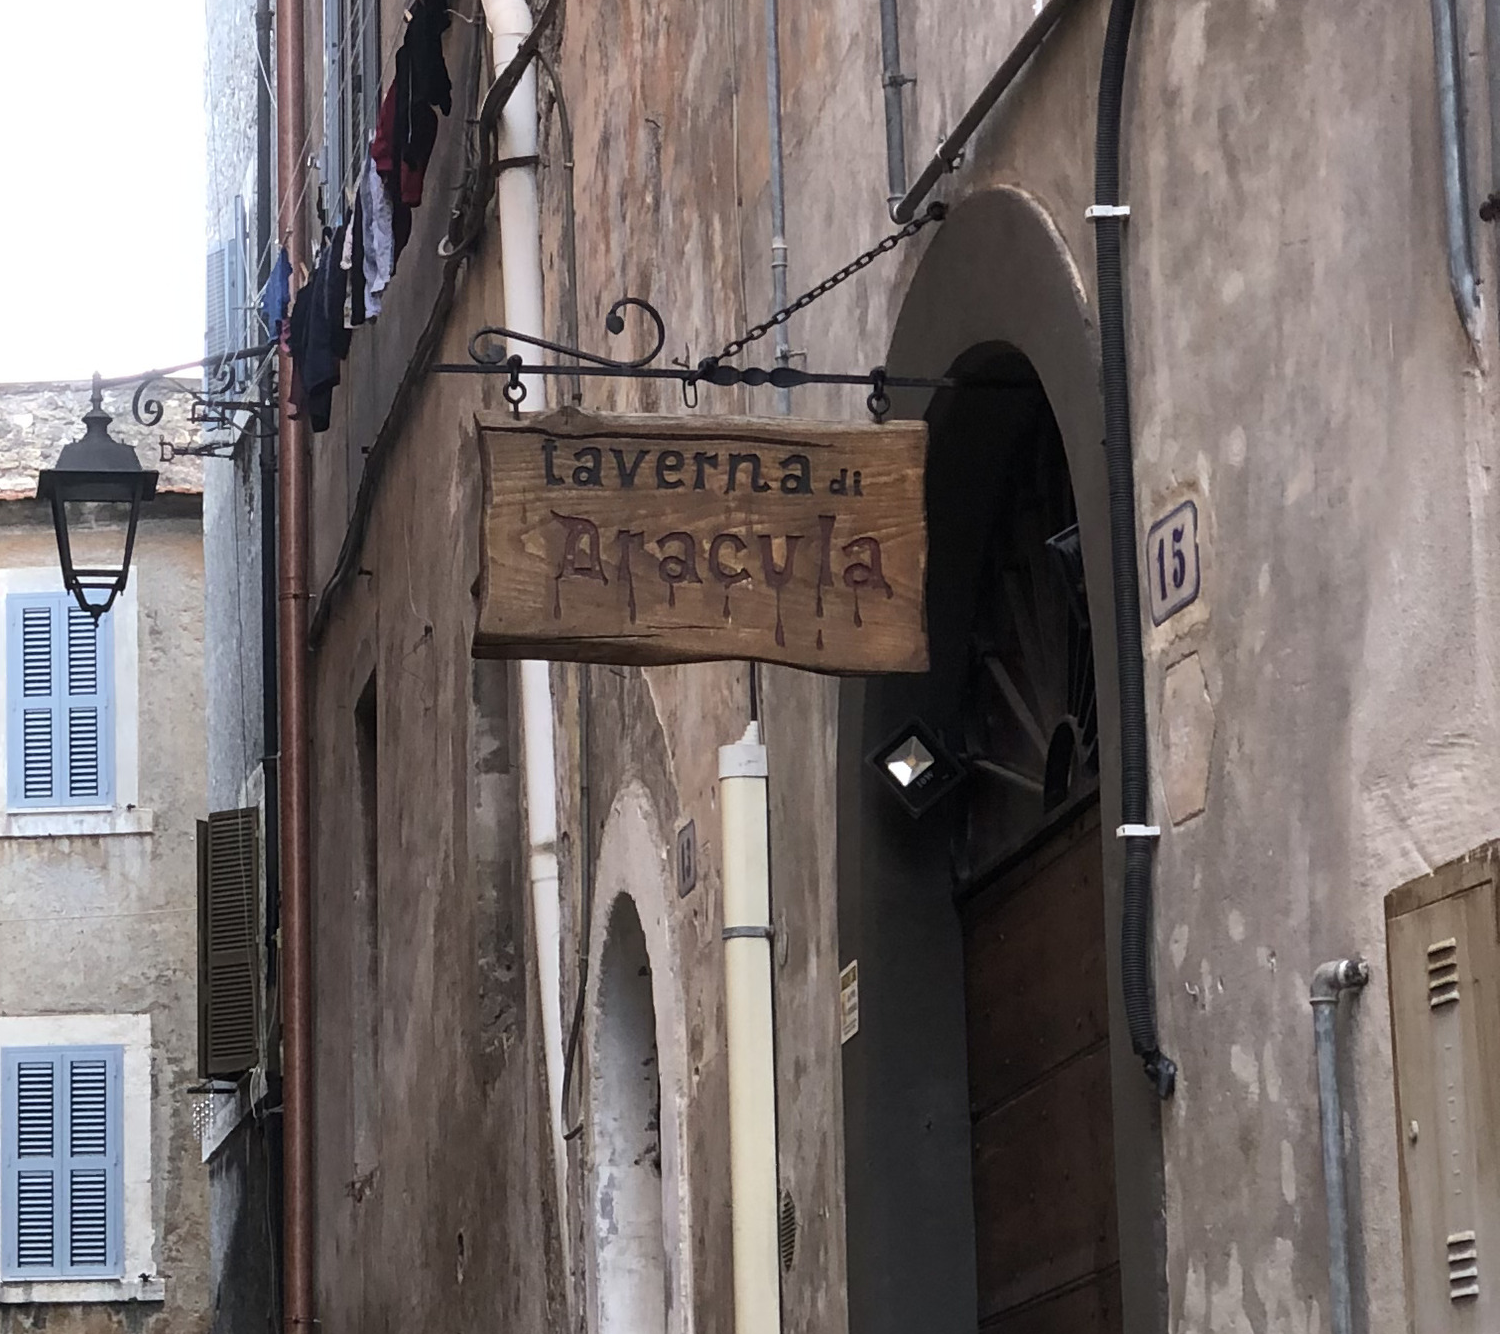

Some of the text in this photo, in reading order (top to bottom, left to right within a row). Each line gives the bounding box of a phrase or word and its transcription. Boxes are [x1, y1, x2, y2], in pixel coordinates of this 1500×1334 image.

[541, 438, 864, 497] taverna di
[1156, 525, 1187, 602] 15
